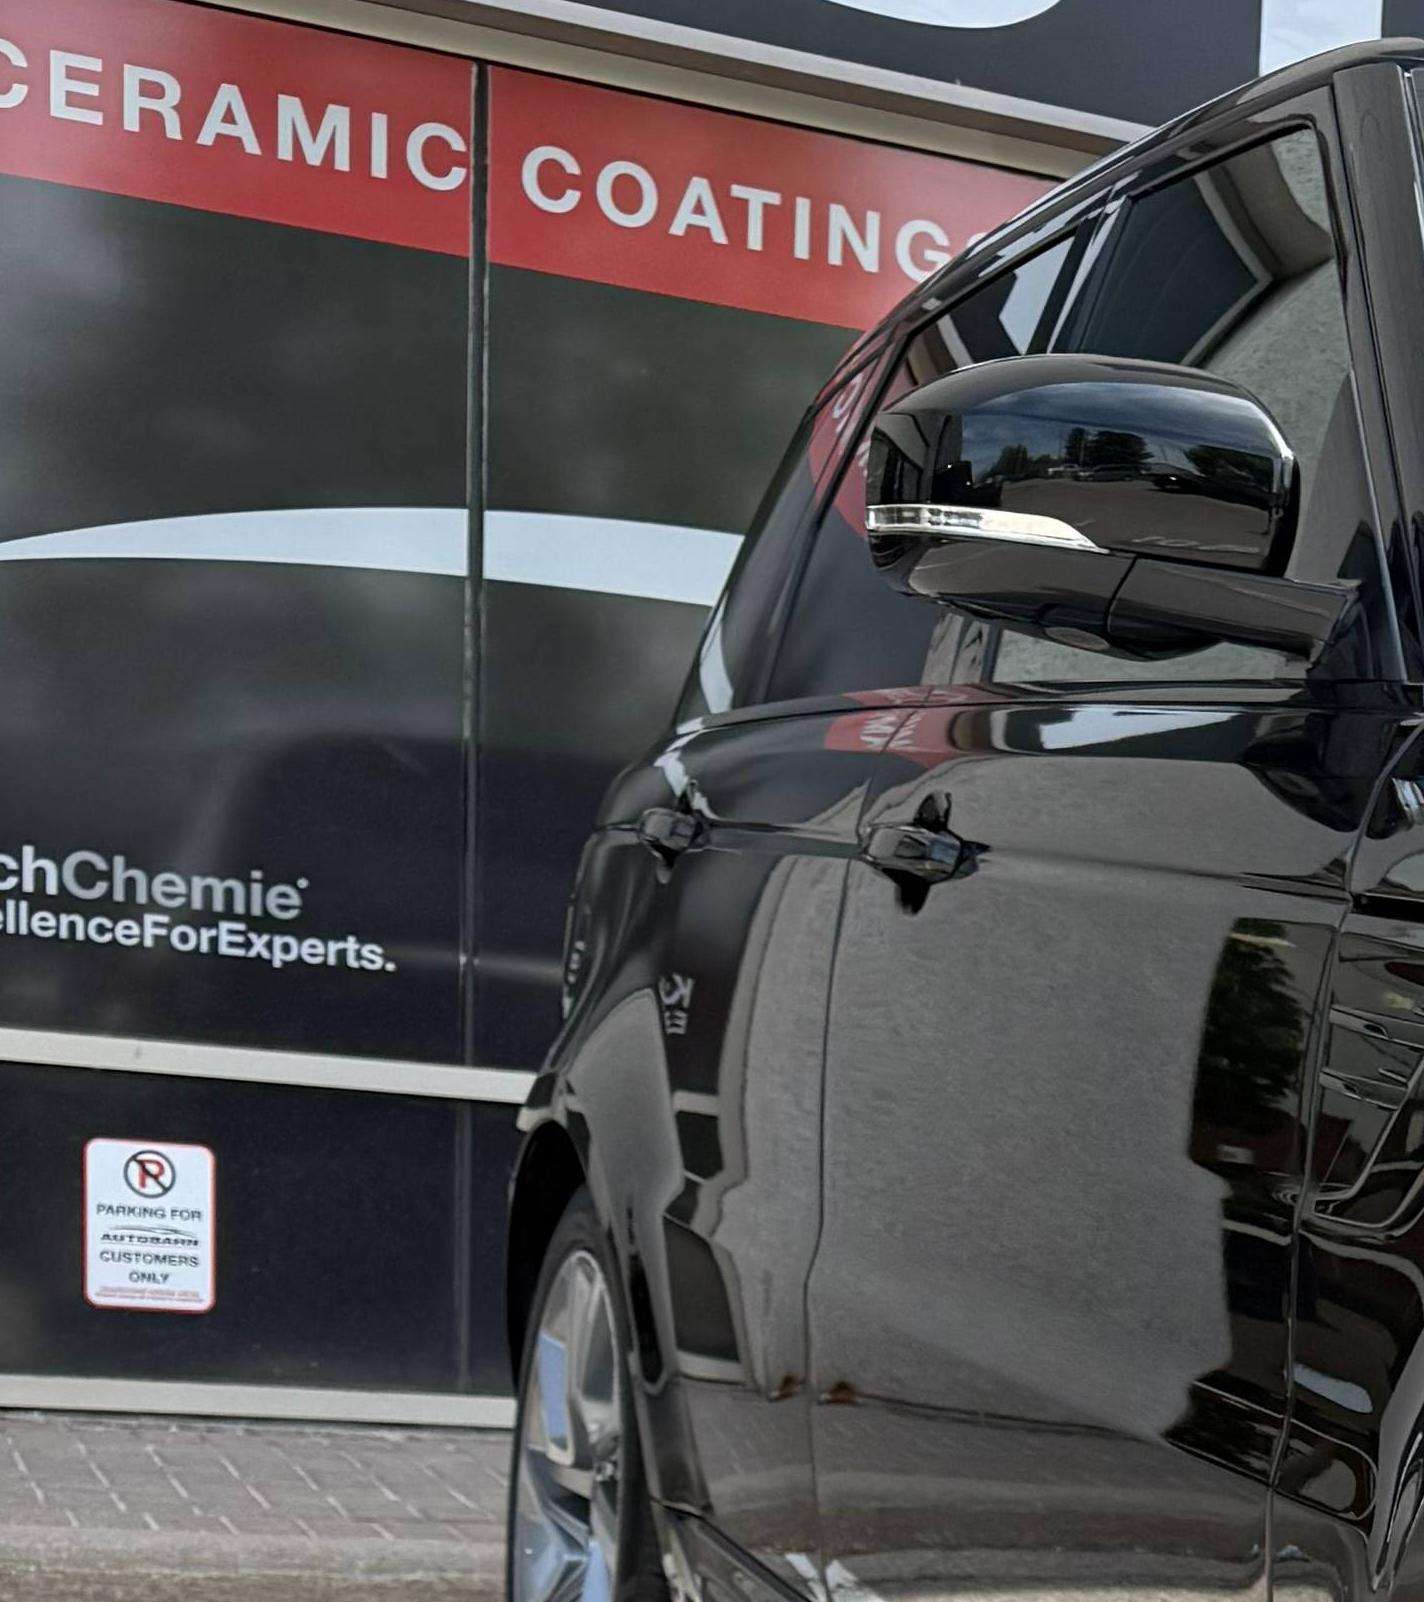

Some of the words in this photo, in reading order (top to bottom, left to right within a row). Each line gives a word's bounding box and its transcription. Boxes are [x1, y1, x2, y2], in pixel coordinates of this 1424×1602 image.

[0, 899, 398, 973] llenceForExperts.
[96, 1203, 167, 1220] PARKING
[170, 1208, 203, 1222] FOR
[100, 1250, 200, 1268] CUSTOMERS
[128, 1270, 170, 1285] ONLY
